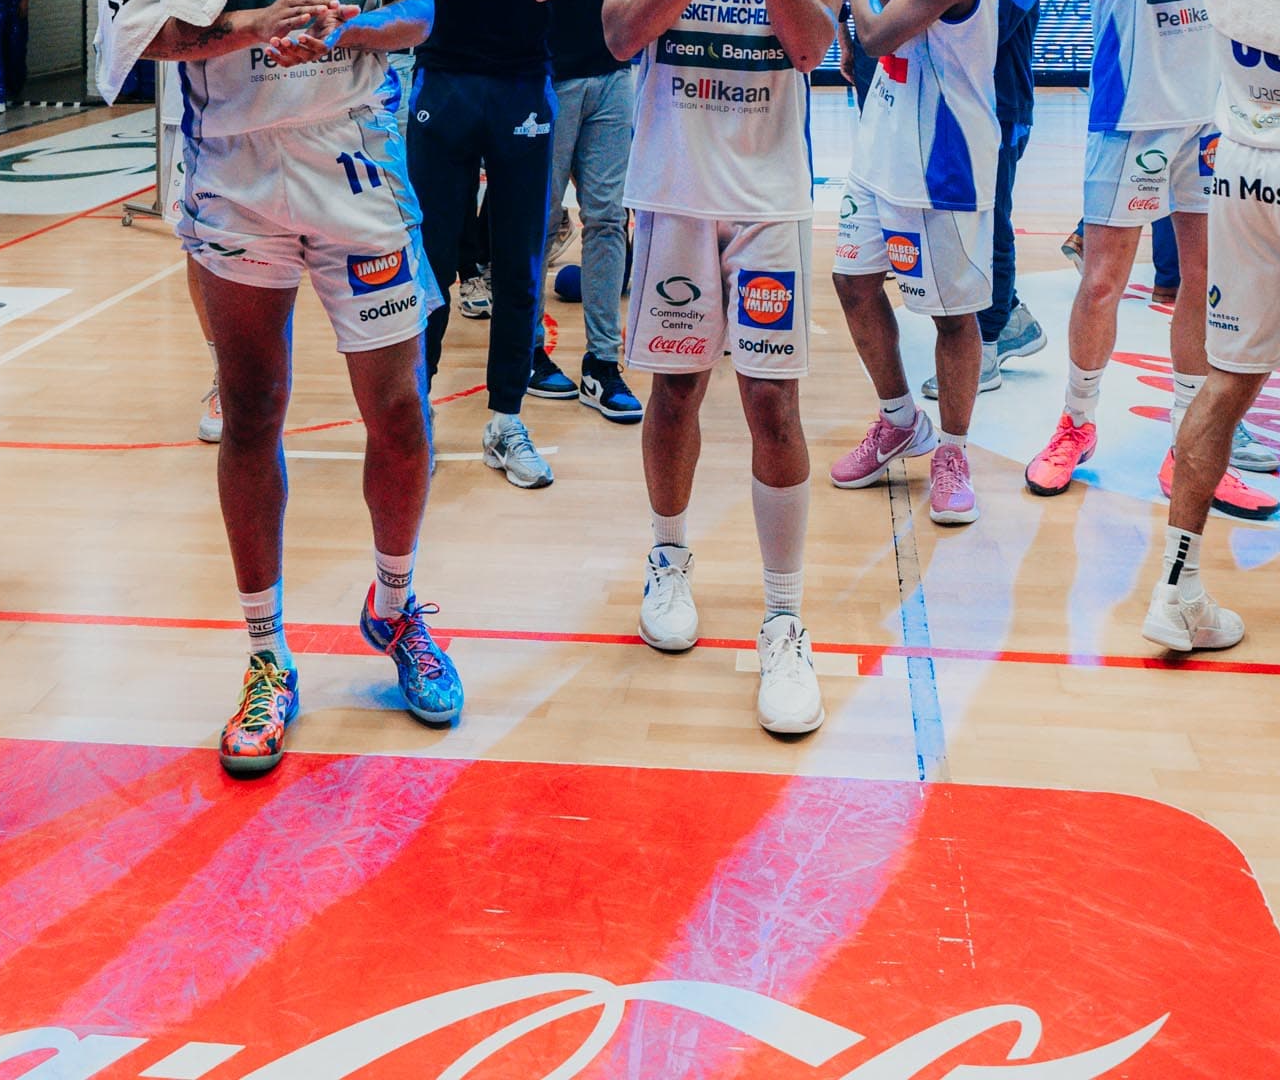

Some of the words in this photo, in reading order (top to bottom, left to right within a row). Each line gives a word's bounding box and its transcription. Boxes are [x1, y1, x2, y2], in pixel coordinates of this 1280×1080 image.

[665, 39, 705, 57] Green
[722, 43, 785, 60] Bananas
[289, 69, 318, 79] BUILD
[671, 77, 771, 102] Pellikaan
[705, 103, 730, 113] BUILD
[335, 151, 382, 195] 11
[355, 251, 399, 277] IMMO
[738, 286, 794, 303] WALBERS
[359, 294, 418, 322] sodiwe
[650, 306, 705, 322] Commodity
[746, 300, 784, 314] IMMO
[661, 319, 694, 331] Centre
[738, 338, 795, 357] sodiwe
